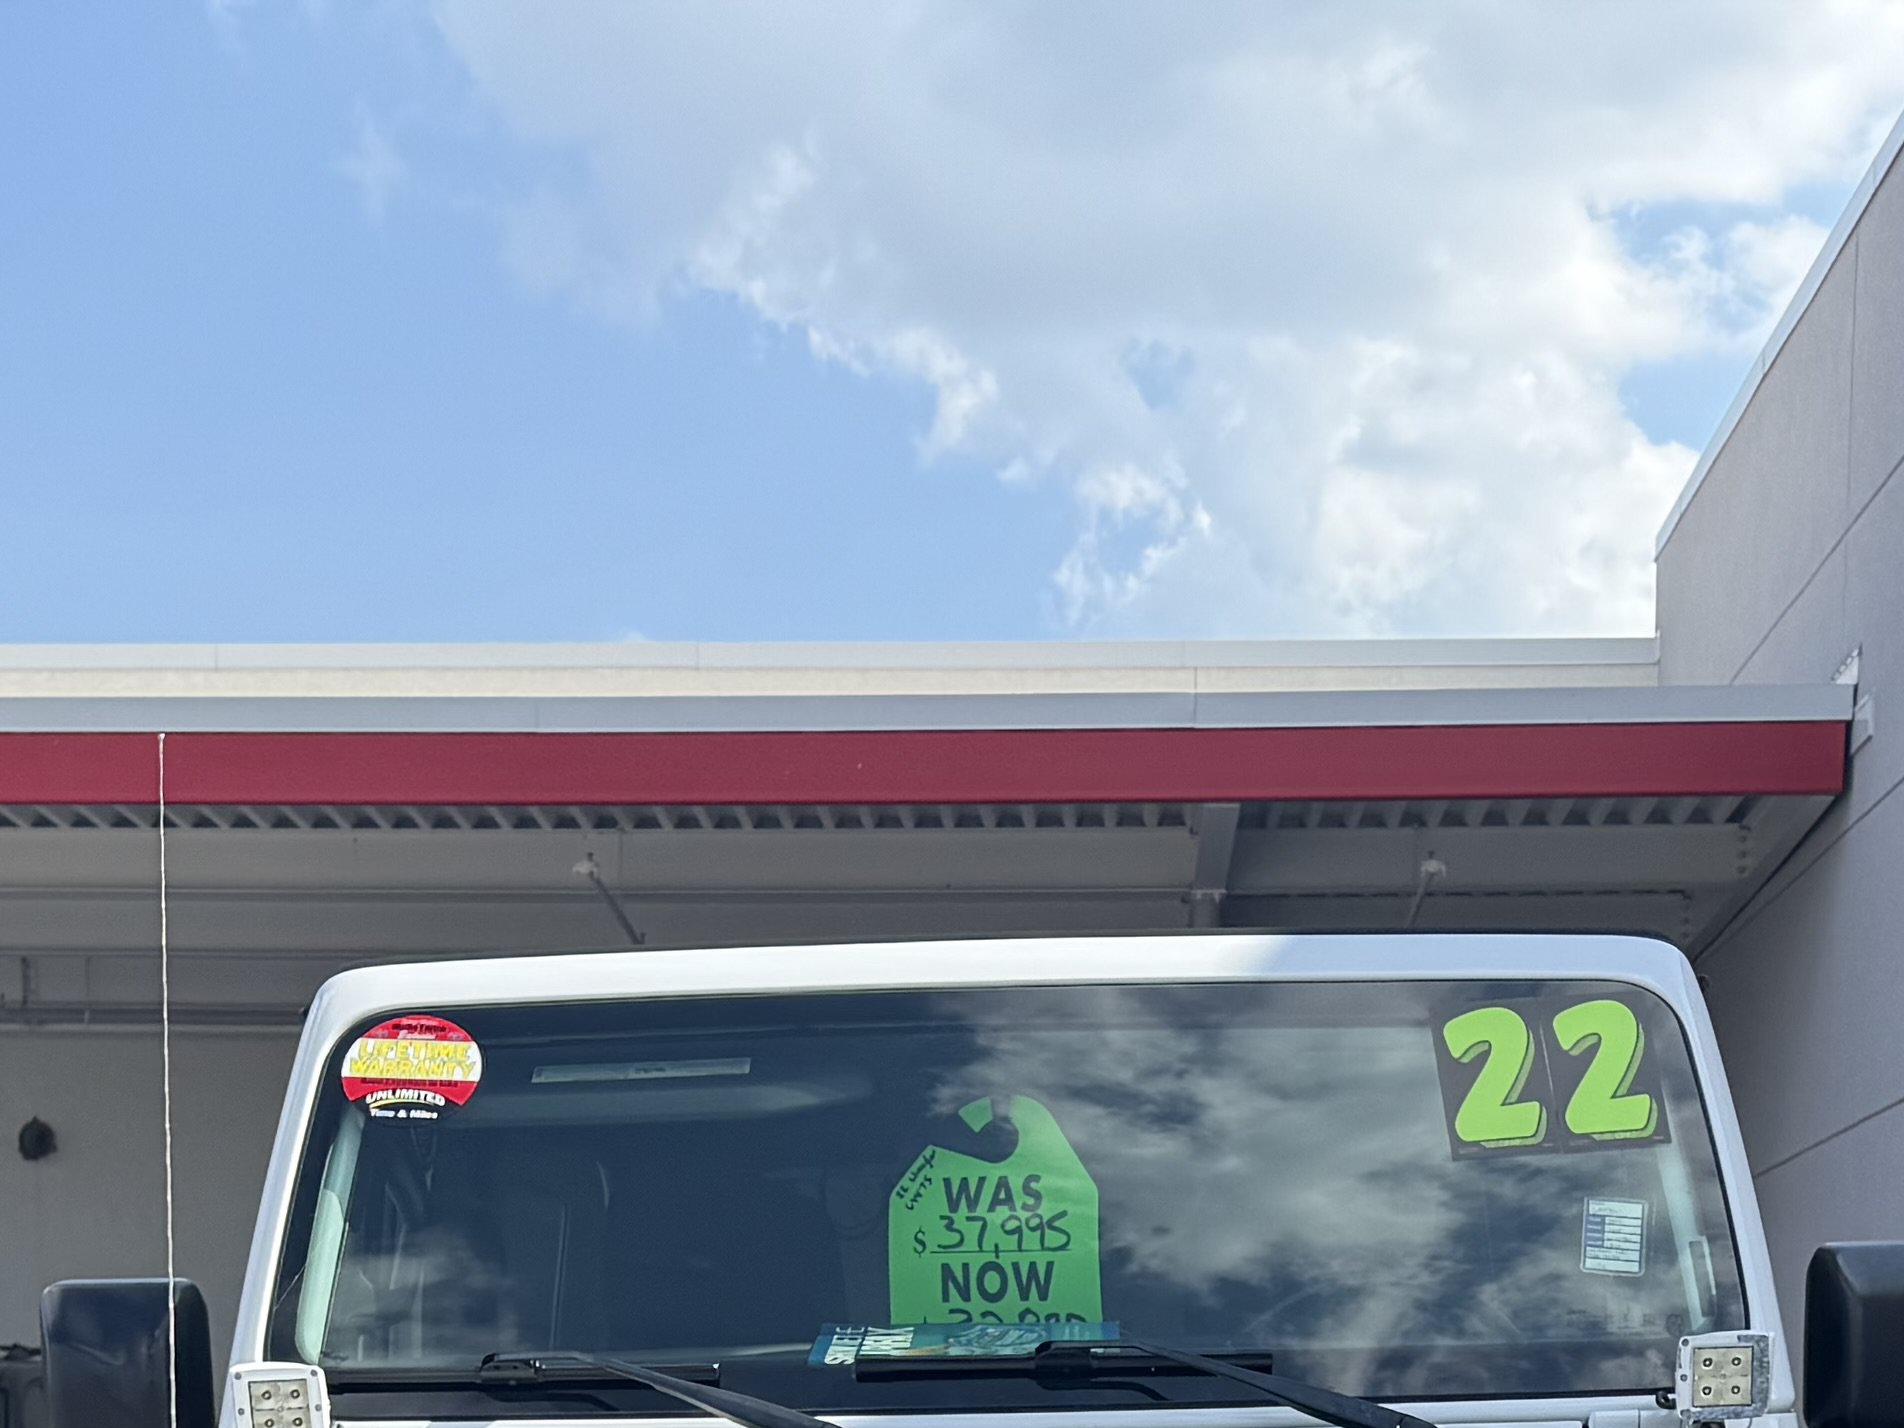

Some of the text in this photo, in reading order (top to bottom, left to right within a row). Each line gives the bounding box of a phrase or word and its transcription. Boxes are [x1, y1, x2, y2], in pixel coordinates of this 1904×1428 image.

[358, 1040, 472, 1061] LIFETIME
[350, 1057, 476, 1080] WARRANTY
[1443, 1000, 1657, 1147] 22
[365, 1088, 446, 1107] UNLIMITED
[941, 1173, 1044, 1214] WAS
[940, 1260, 1055, 1304] NOW
